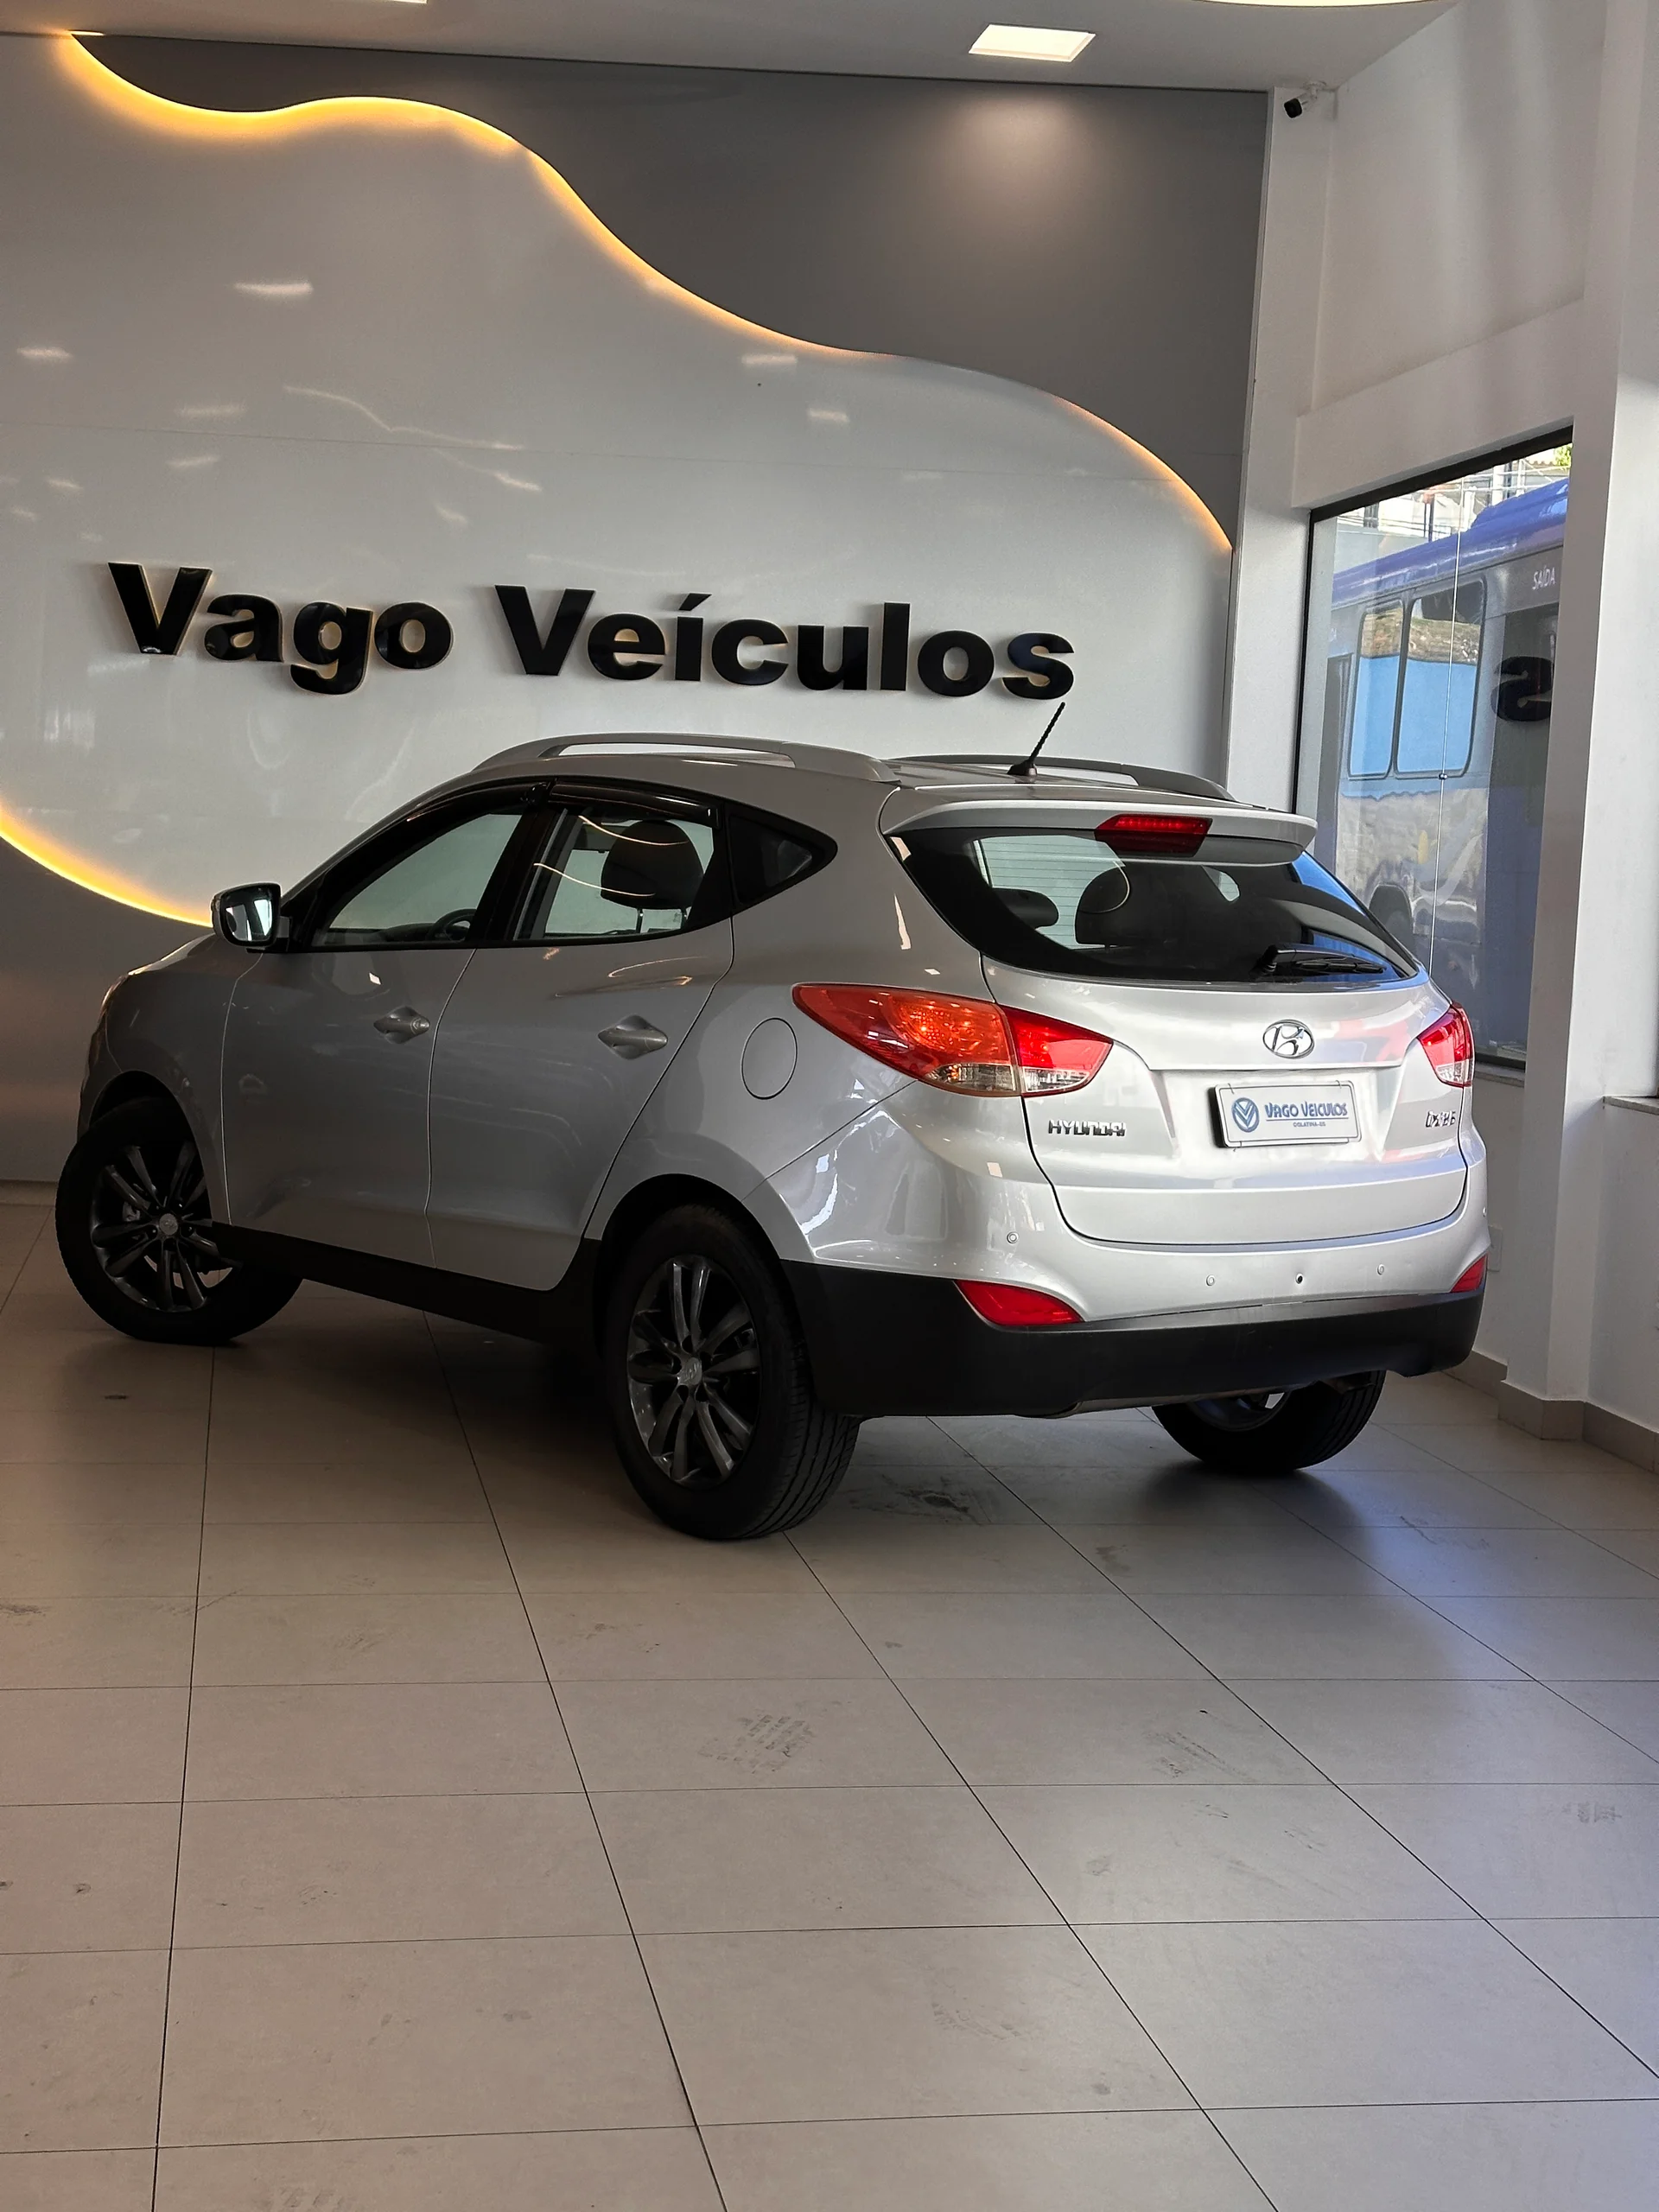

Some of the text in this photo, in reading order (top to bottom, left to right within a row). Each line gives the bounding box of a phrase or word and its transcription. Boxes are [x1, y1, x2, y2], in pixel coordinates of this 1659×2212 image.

[1532, 565, 1555, 591] SAÍDA
[107, 562, 1075, 699] Vago Veículos
[1264, 1102, 1299, 1118] VAGO
[1048, 1120, 1126, 1136] HYUNDAI
